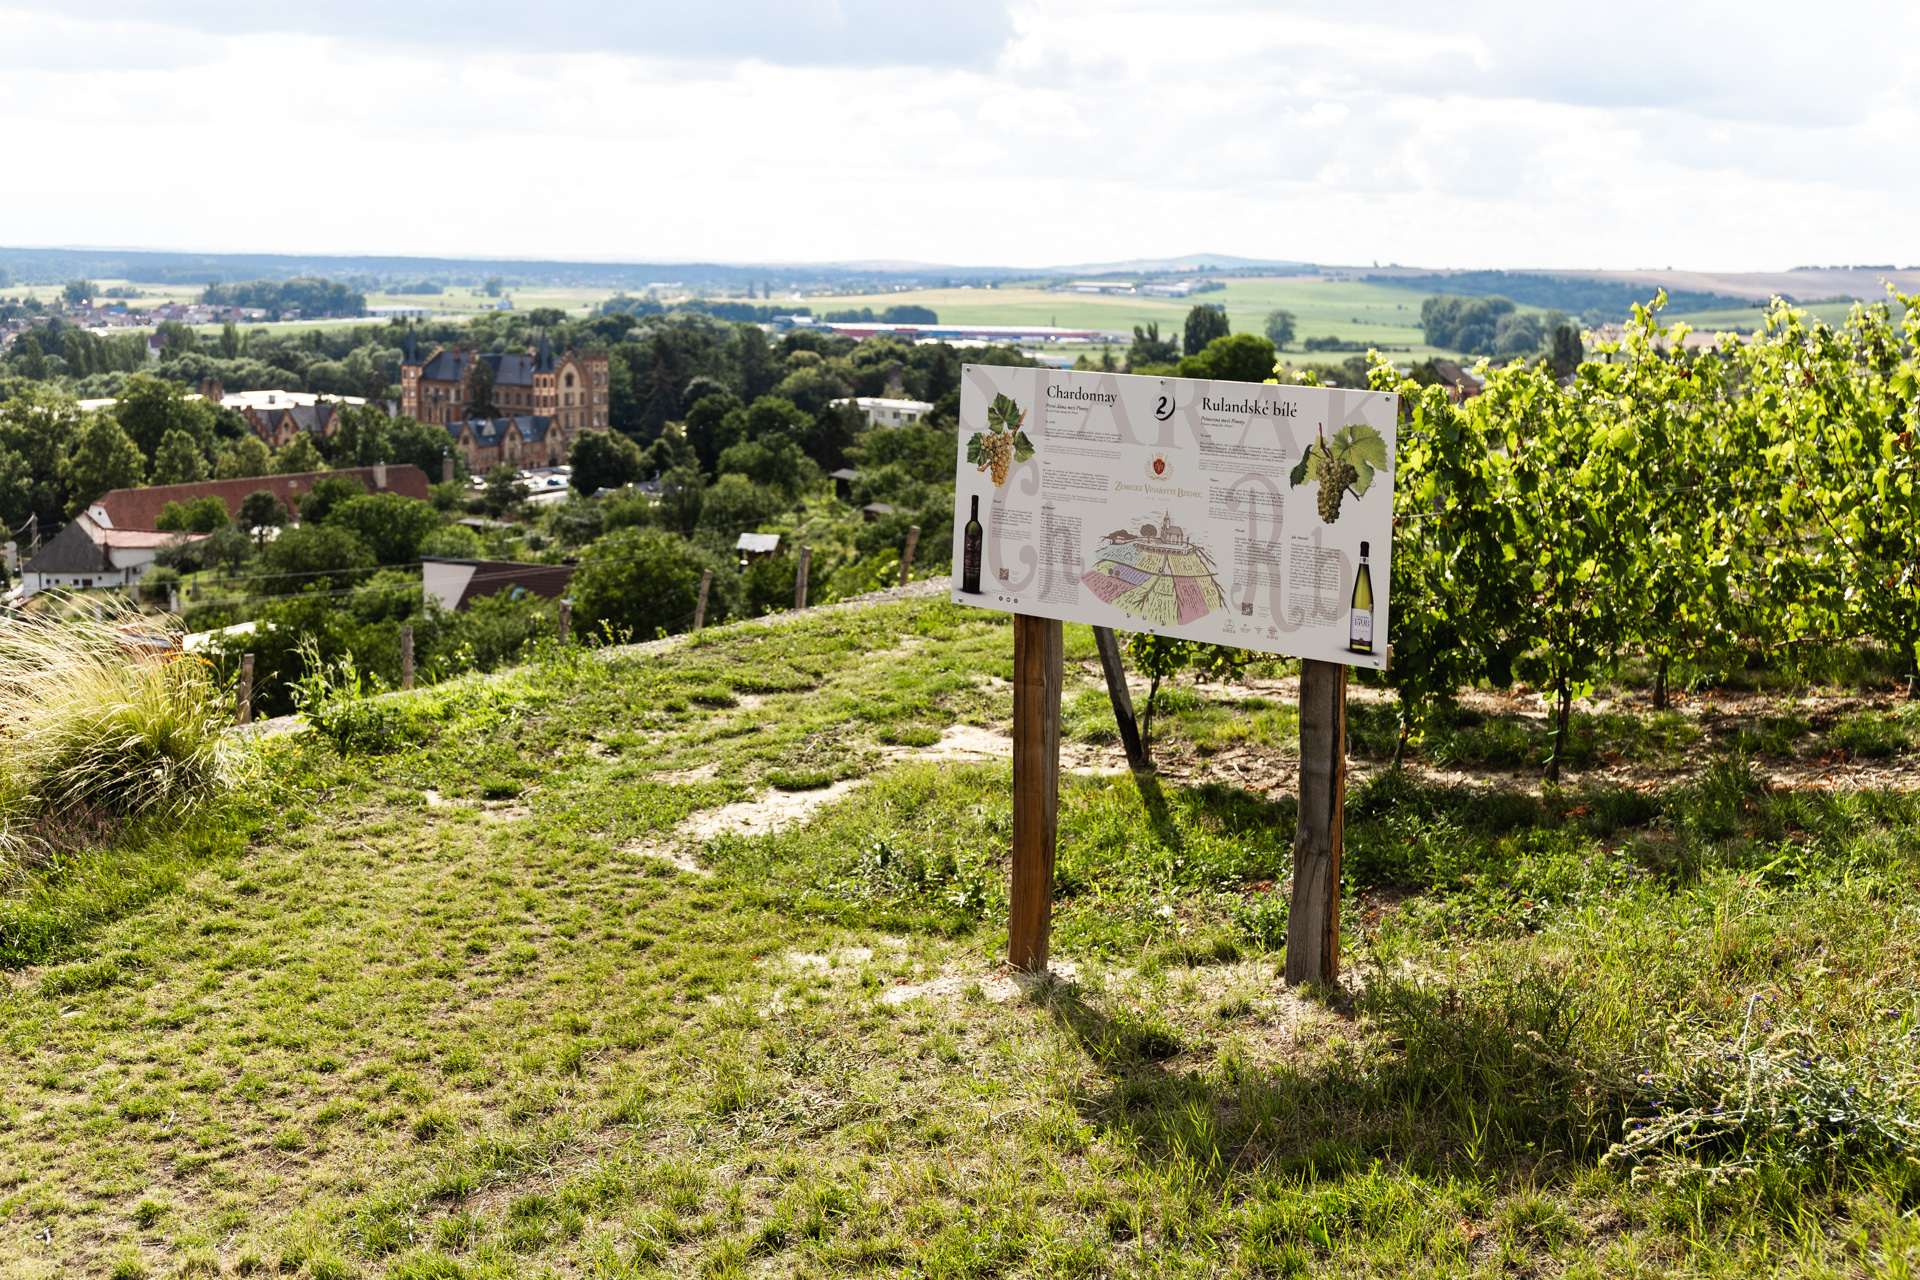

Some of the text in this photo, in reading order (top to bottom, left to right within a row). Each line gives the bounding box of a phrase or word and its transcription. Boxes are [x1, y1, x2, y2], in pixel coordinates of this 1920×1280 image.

[1046, 385, 1117, 408] Chardonnay
[1155, 396, 1167, 415] 2
[1202, 397, 1298, 418] Rulandské bílé
[1177, 488, 1203, 498] BZENEC
